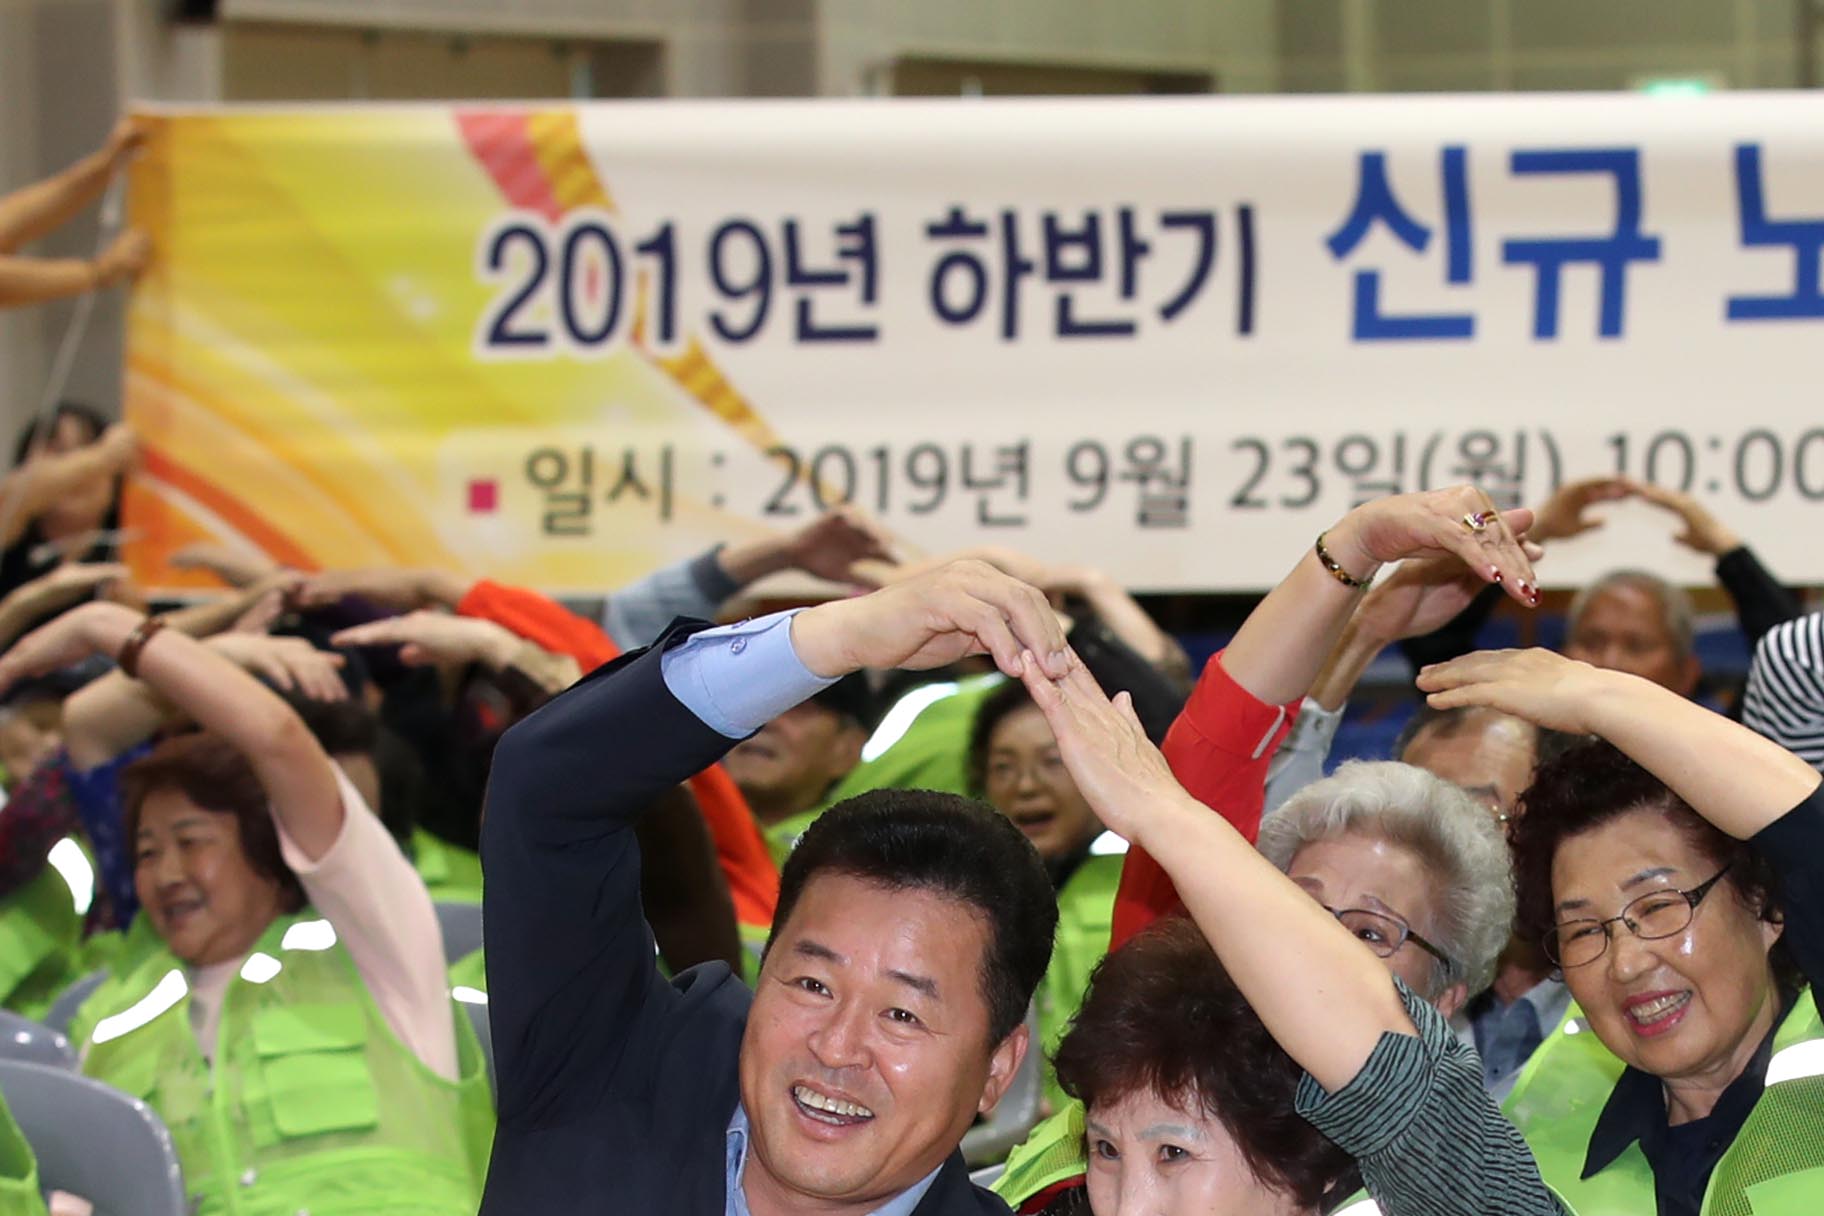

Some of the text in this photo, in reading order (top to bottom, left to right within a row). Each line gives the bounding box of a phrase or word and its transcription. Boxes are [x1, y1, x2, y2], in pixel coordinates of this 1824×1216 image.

[484, 209, 881, 349] 2019년
[924, 202, 1256, 342] 하반기
[1325, 144, 1661, 342] 신규
[525, 441, 675, 537] 일시
[761, 436, 1032, 526] 2019년
[1064, 434, 1195, 529] 9월
[1228, 428, 1564, 512] 23일(월)
